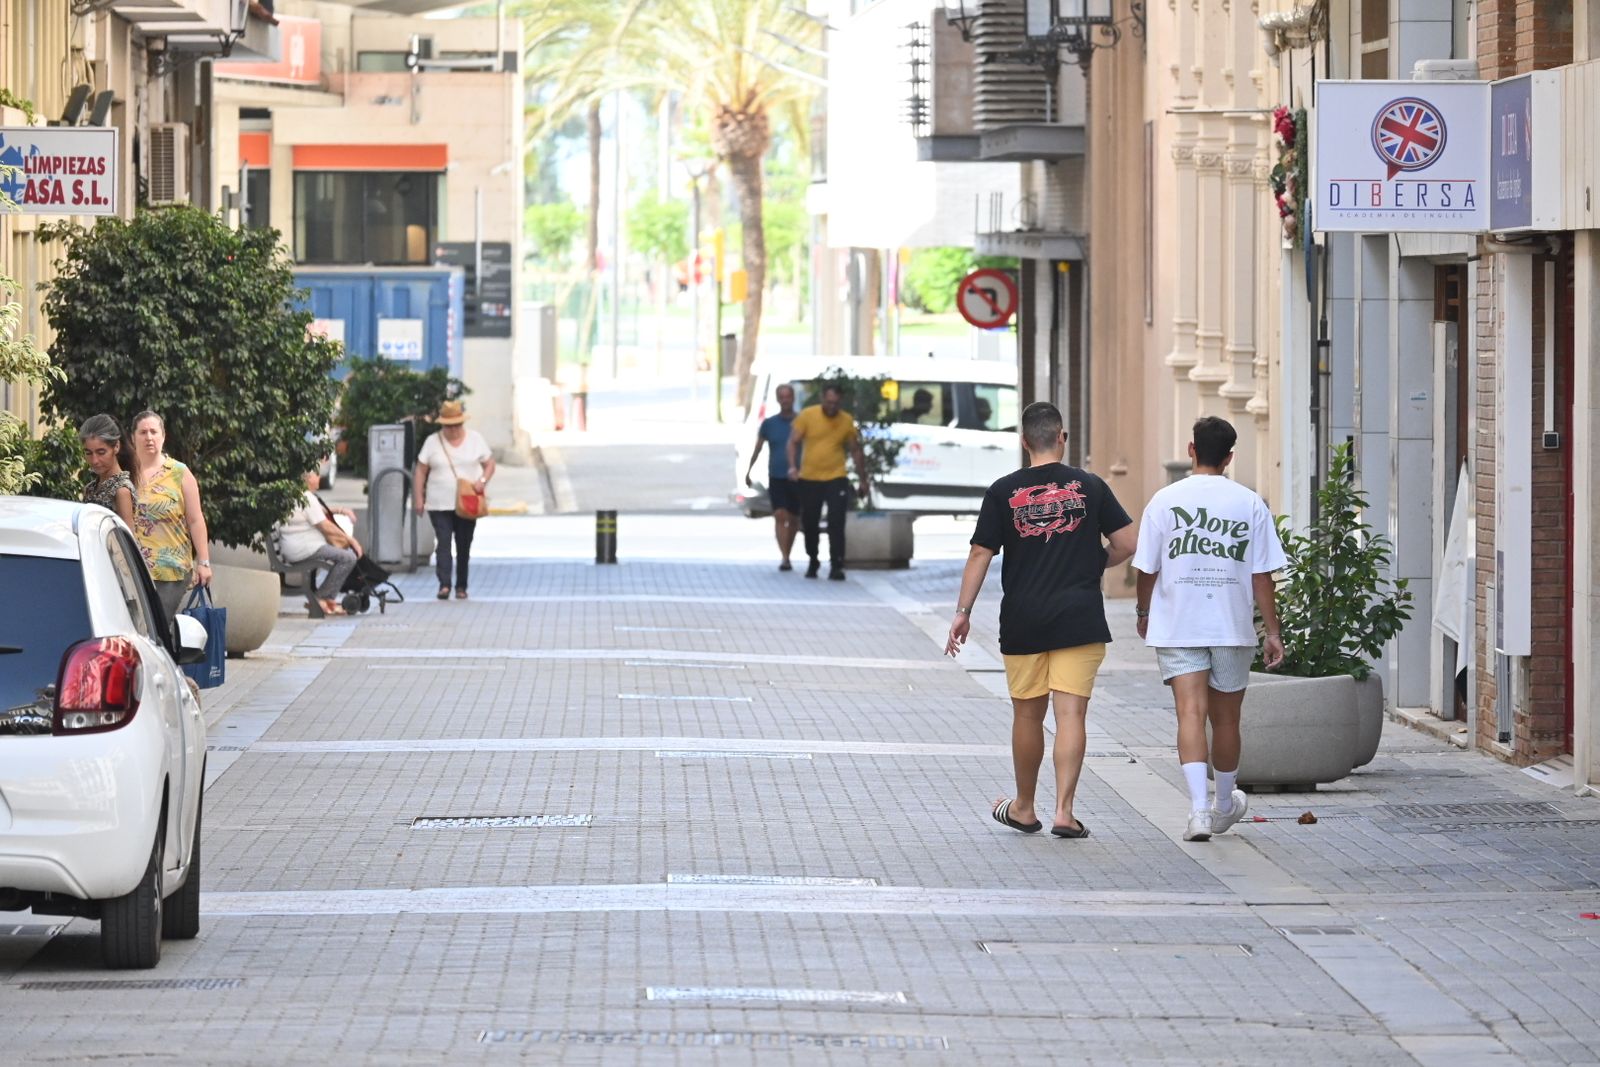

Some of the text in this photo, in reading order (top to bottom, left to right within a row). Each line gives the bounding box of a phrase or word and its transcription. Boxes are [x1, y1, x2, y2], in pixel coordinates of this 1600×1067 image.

[24, 155, 106, 176] LIMPIEZAS
[23, 179, 109, 206] ASA S.L.
[1329, 183, 1476, 207] DIBERSA
[1169, 506, 1250, 539] Move
[1168, 530, 1250, 563] ahead
